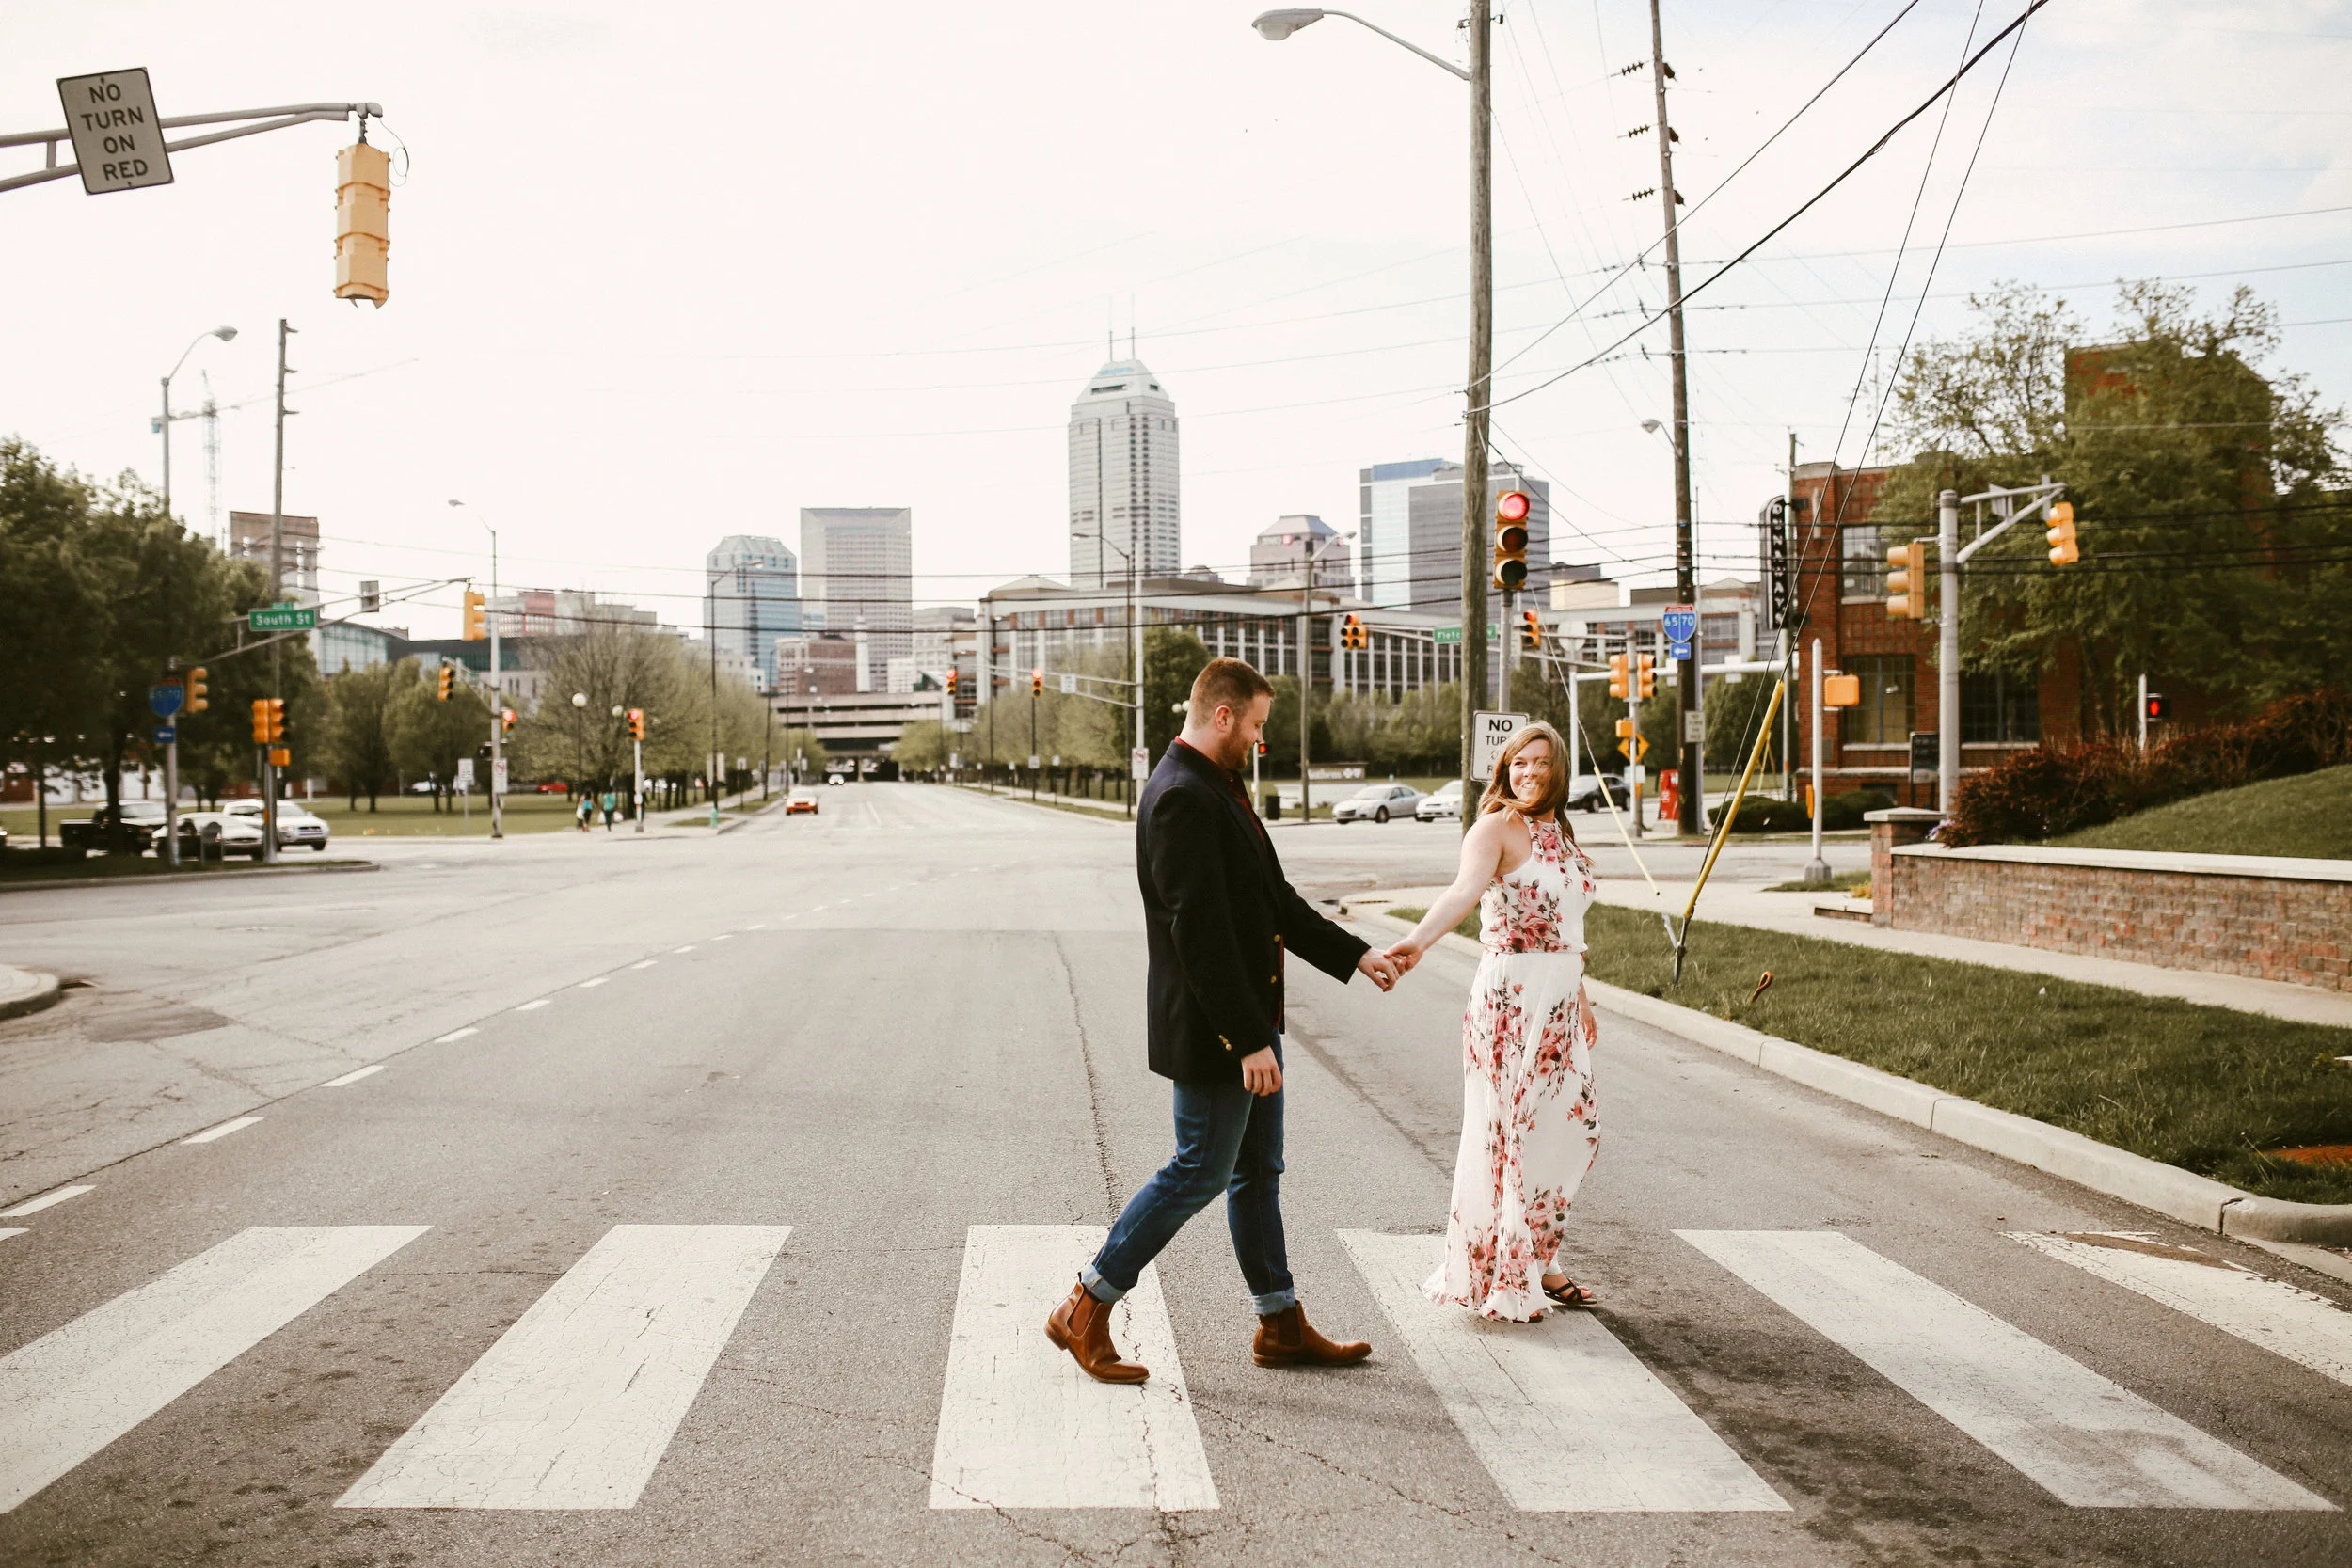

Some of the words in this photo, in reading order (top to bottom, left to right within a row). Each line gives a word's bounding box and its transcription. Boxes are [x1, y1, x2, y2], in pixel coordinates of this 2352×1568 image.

[88, 83, 121, 103] NO
[80, 106, 144, 131] TURN
[103, 134, 135, 154] ON
[102, 159, 148, 181] RED
[255, 613, 292, 626] South
[296, 612, 310, 625] St
[1664, 616, 1678, 627] 65
[1681, 616, 1694, 626] 70
[1488, 719, 1513, 732] NO
[1486, 735, 1509, 746] TUR
